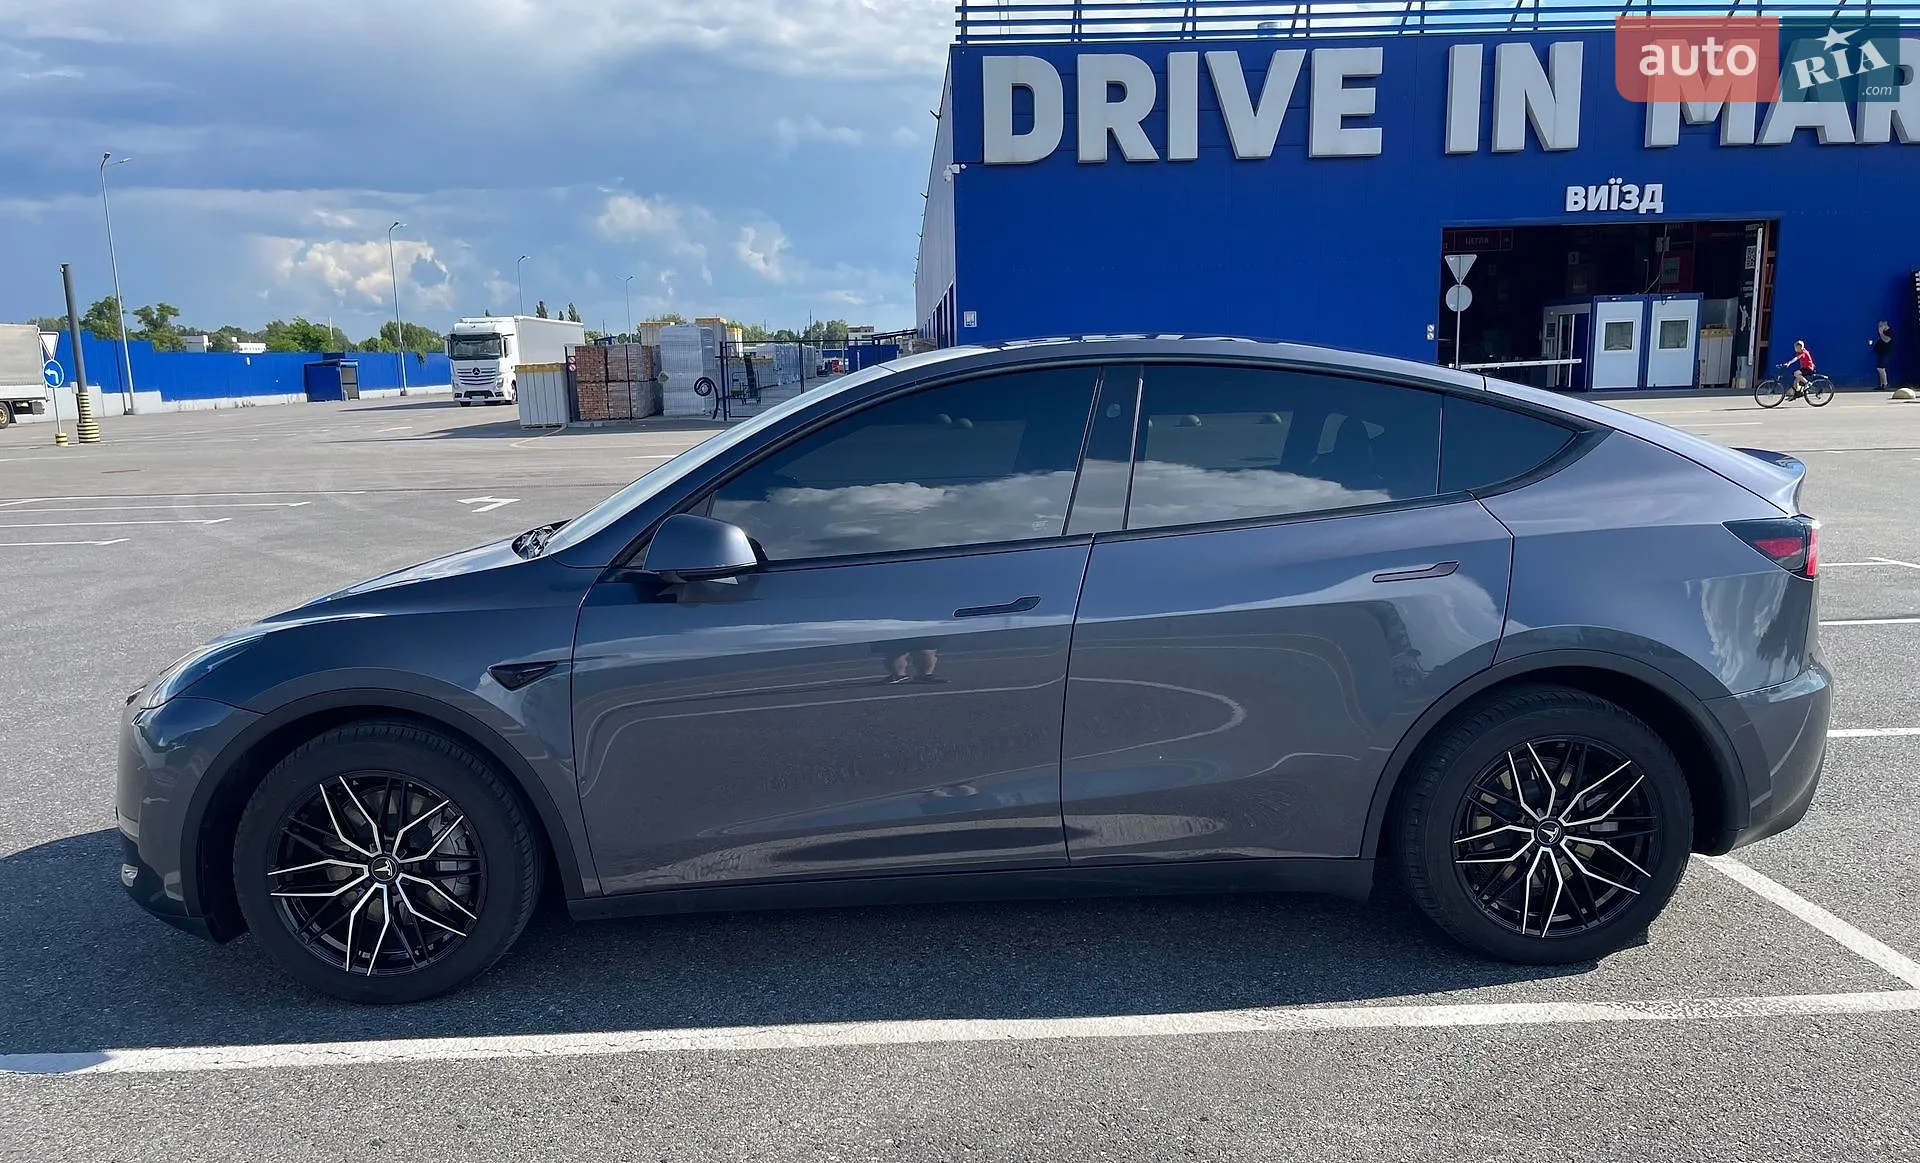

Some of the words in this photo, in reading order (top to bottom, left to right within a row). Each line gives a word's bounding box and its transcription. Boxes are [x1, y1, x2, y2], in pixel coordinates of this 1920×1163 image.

[983, 46, 1383, 165] DRIVE
[1445, 41, 1584, 154] IN
[1565, 177, 1664, 214] ВИЇЗД
